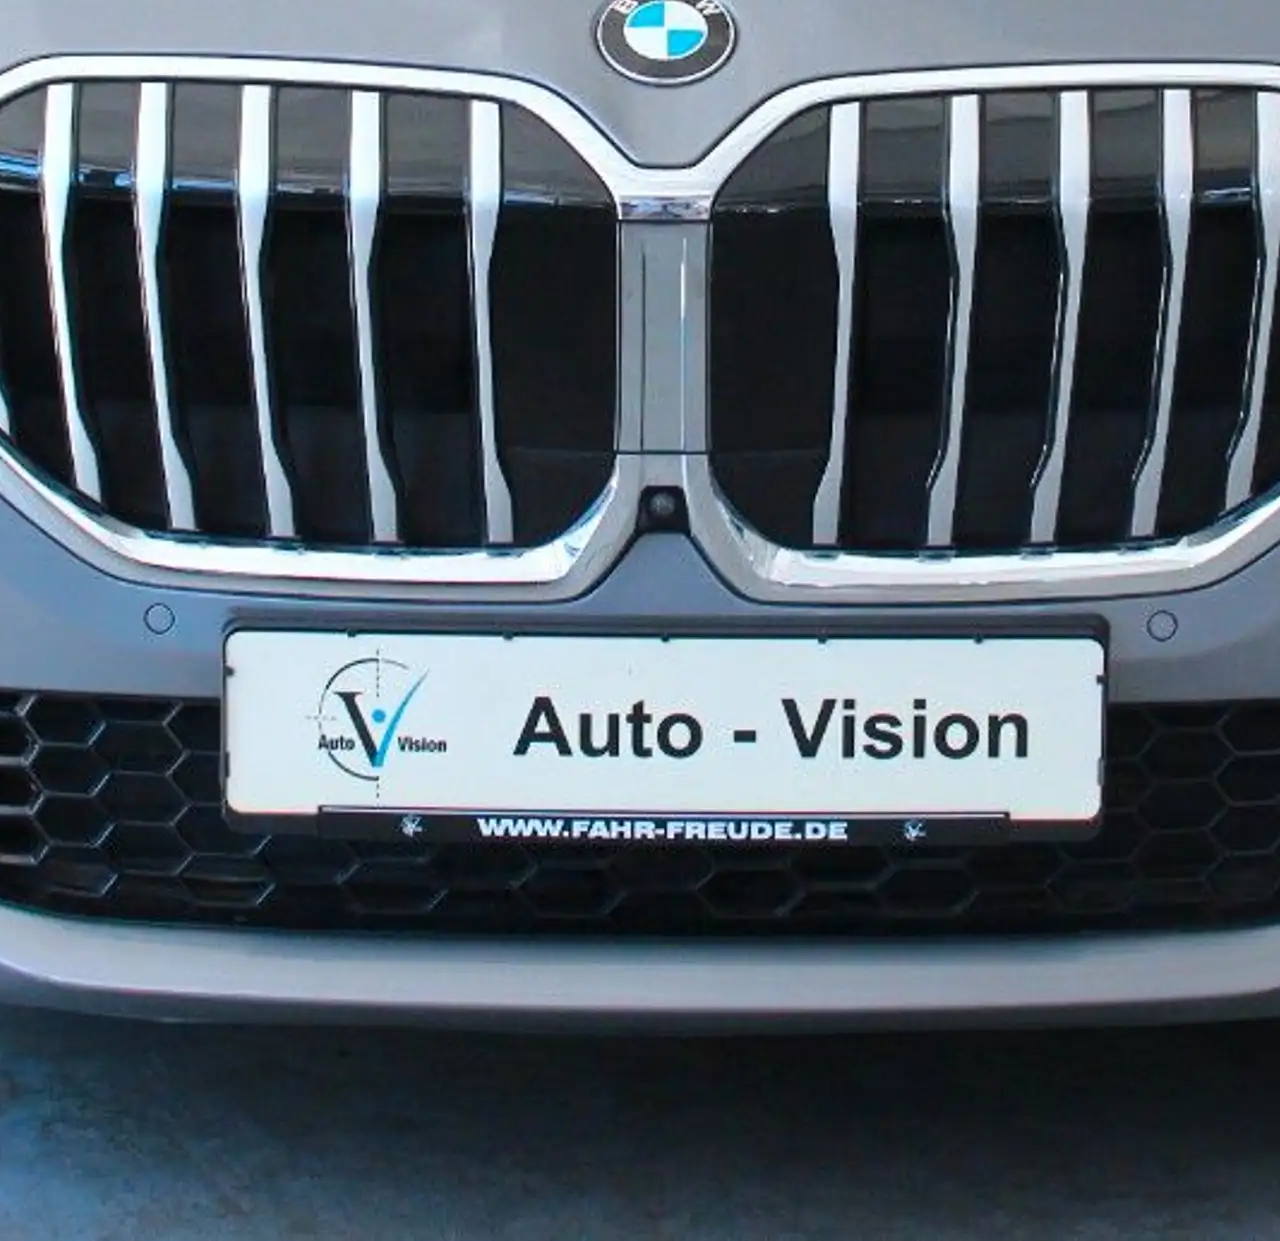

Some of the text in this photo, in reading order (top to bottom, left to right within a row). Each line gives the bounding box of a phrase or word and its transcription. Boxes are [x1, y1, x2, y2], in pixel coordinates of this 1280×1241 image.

[513, 696, 1029, 759] Auto - Vision
[318, 734, 447, 753] Auto Vision
[476, 817, 849, 841] WWW.FAHR-FREUDE.DE
